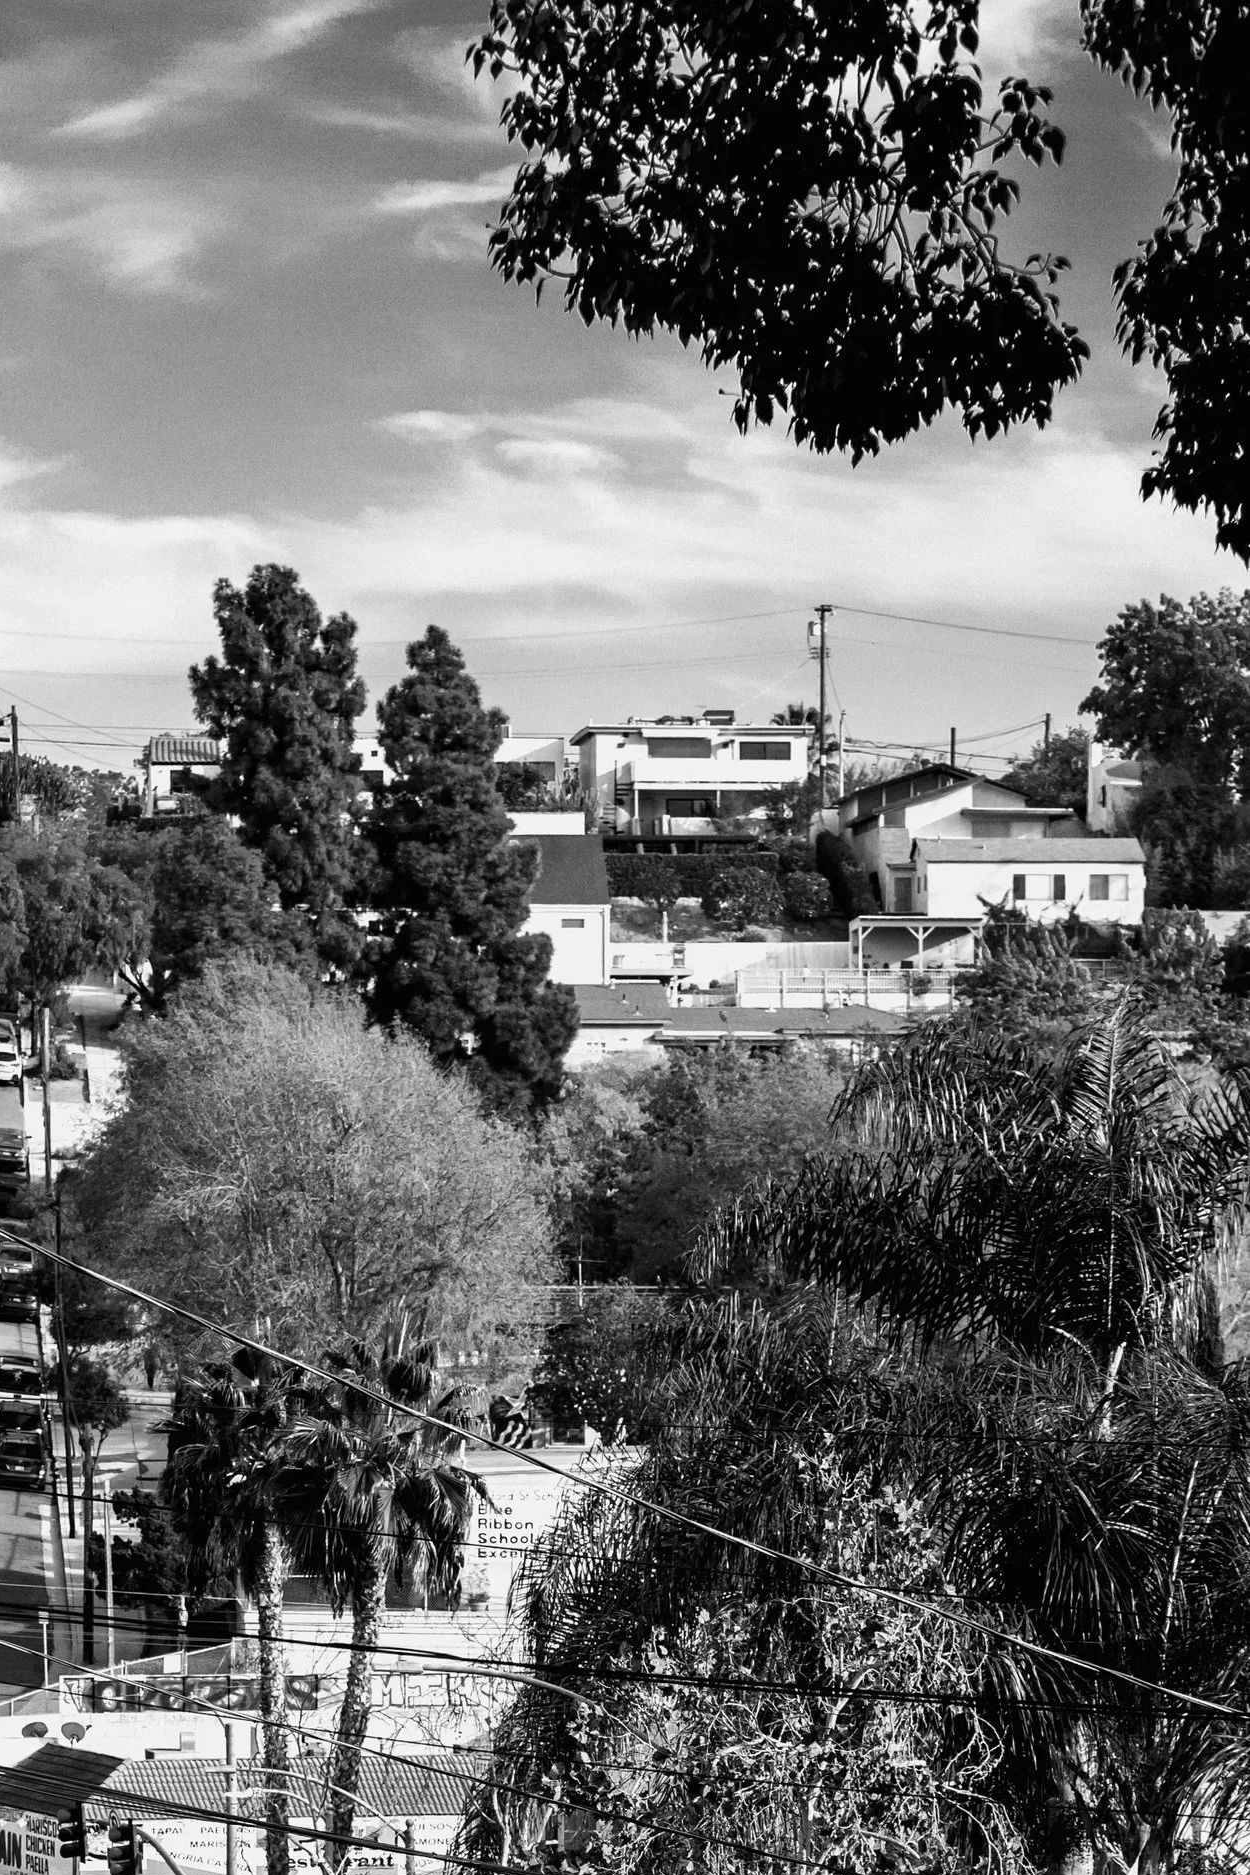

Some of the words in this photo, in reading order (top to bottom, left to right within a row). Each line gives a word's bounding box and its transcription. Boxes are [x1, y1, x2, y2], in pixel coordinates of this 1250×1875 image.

[478, 1518, 534, 1530] Ribbon
[478, 1532, 534, 1544] School
[26, 1834, 55, 1857] CHICKEN
[26, 1854, 49, 1875] PAELLA
